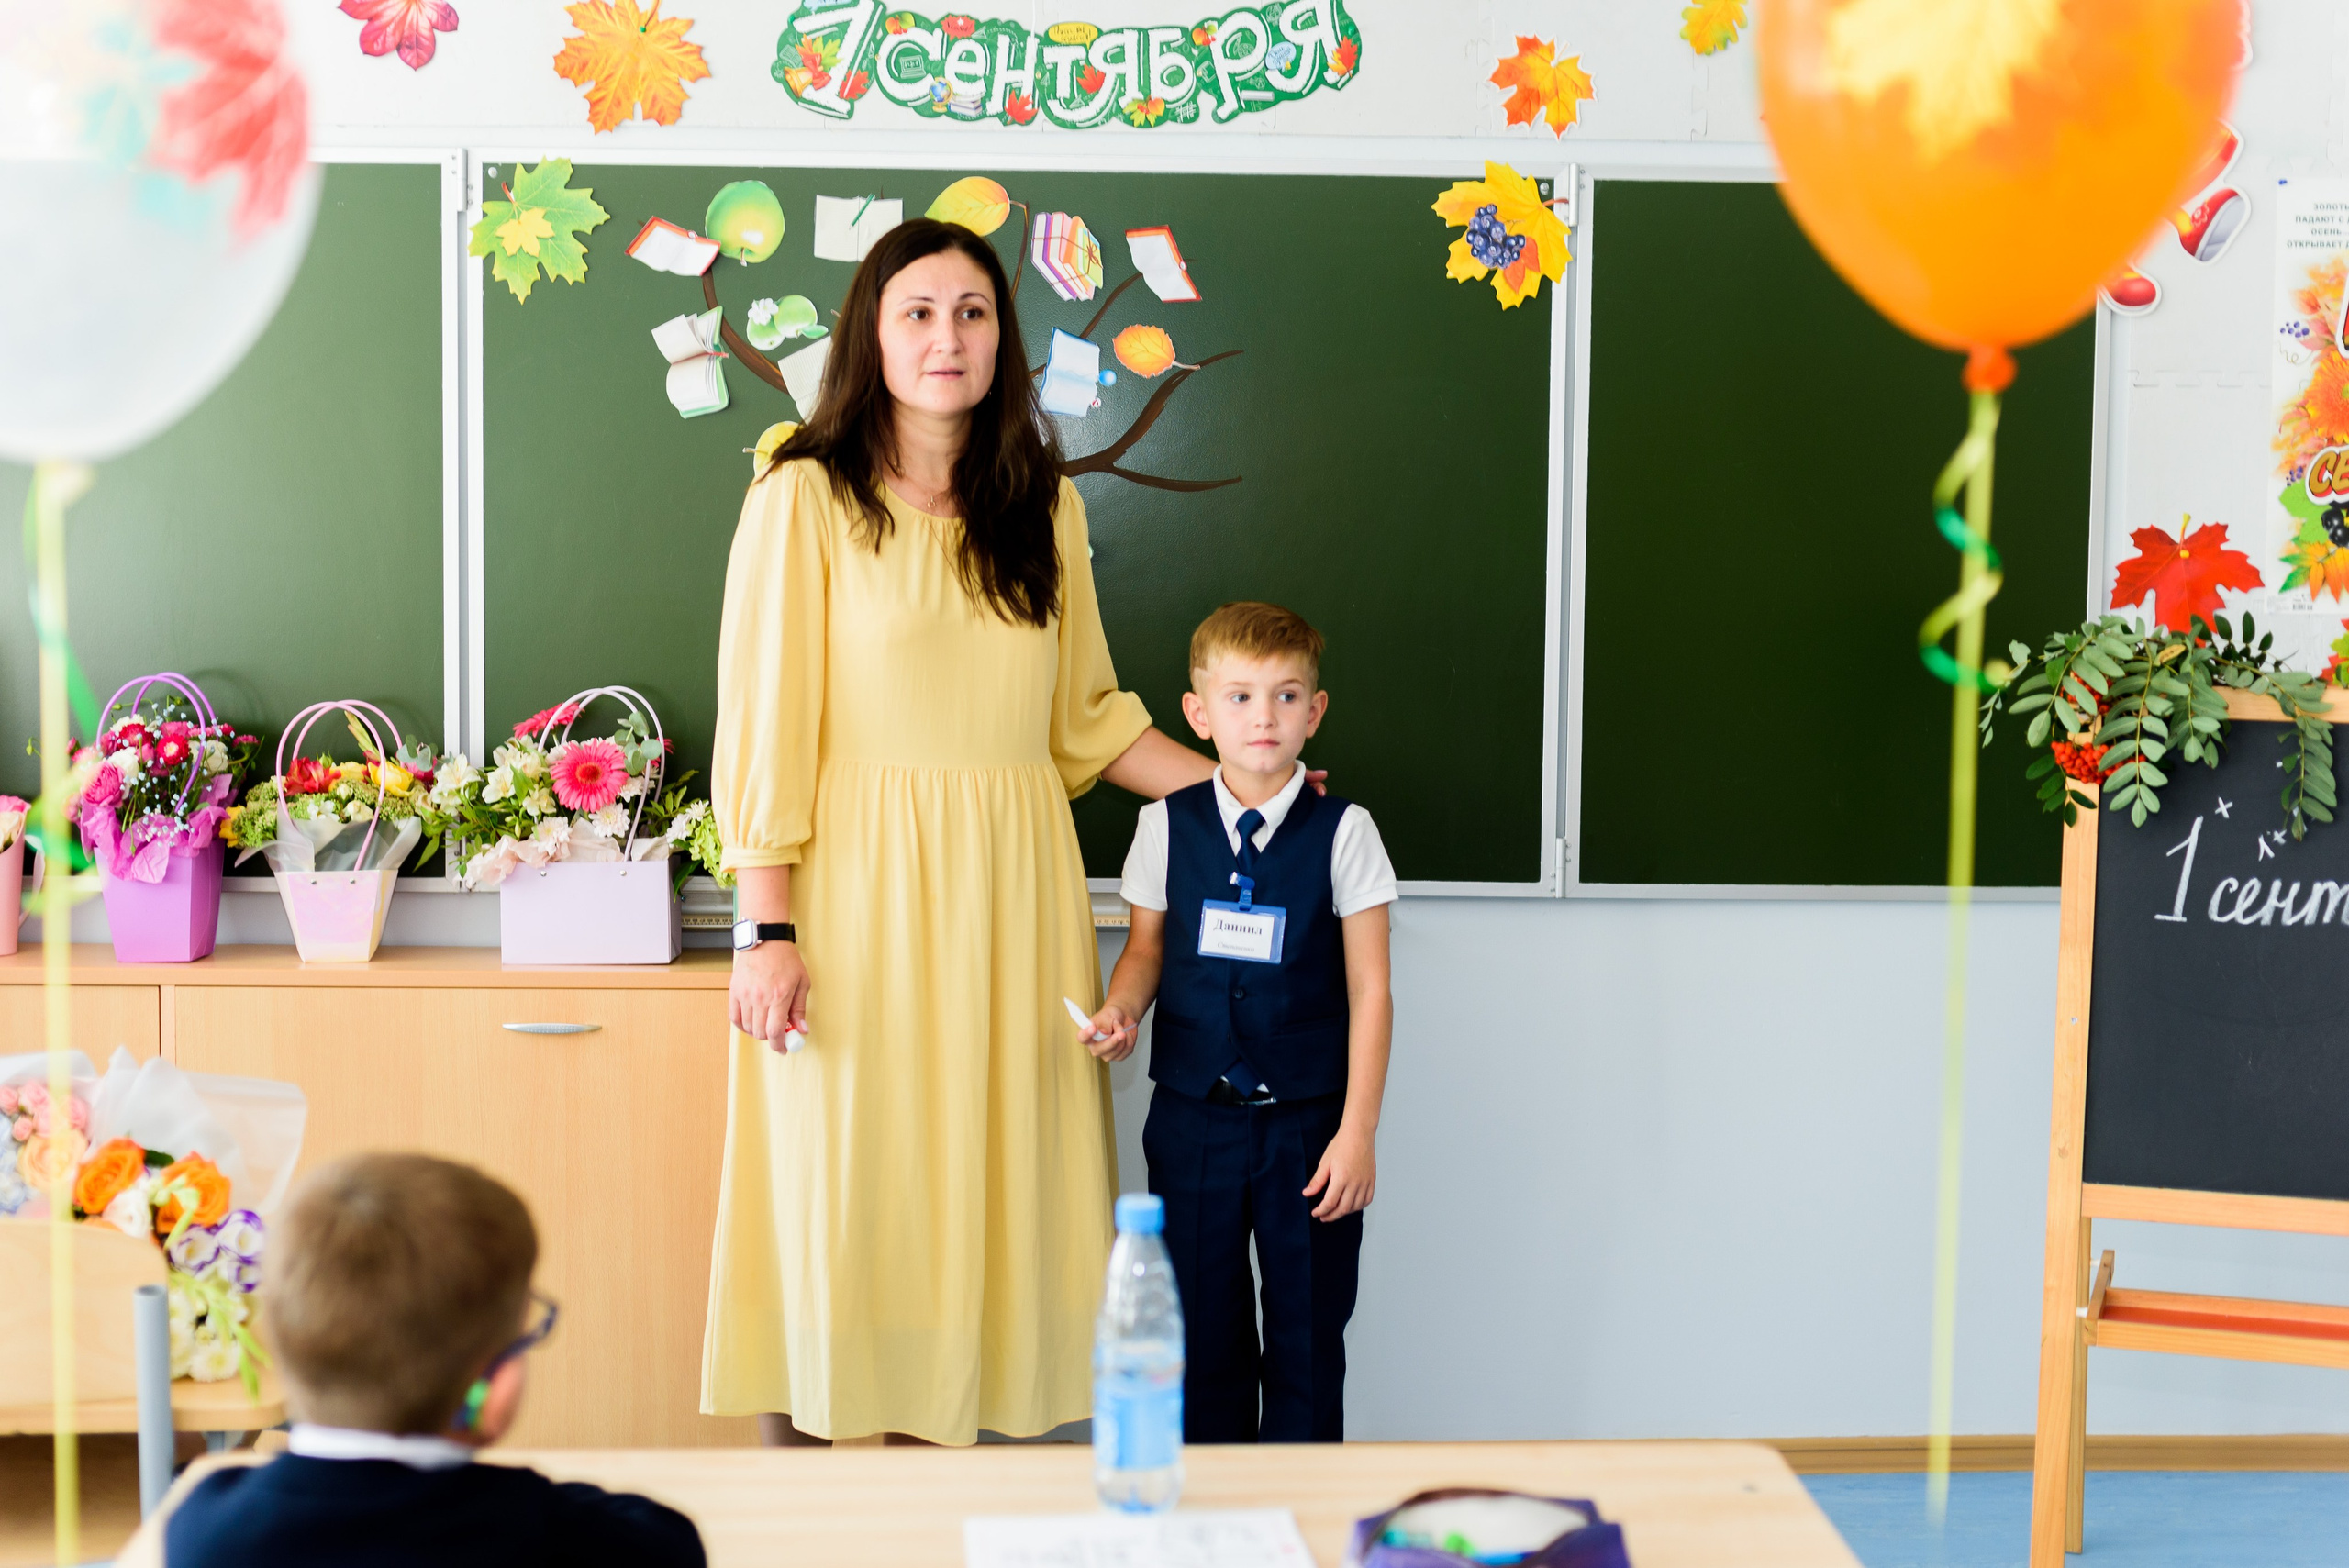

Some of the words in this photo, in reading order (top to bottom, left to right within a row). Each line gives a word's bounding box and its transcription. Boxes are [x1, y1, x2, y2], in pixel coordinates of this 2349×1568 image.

[2295, 215, 2335, 224] ПАДАЮТ
[2287, 239, 2343, 249] ОТКРЫВАЕТ
[2154, 815, 2204, 923] 1
